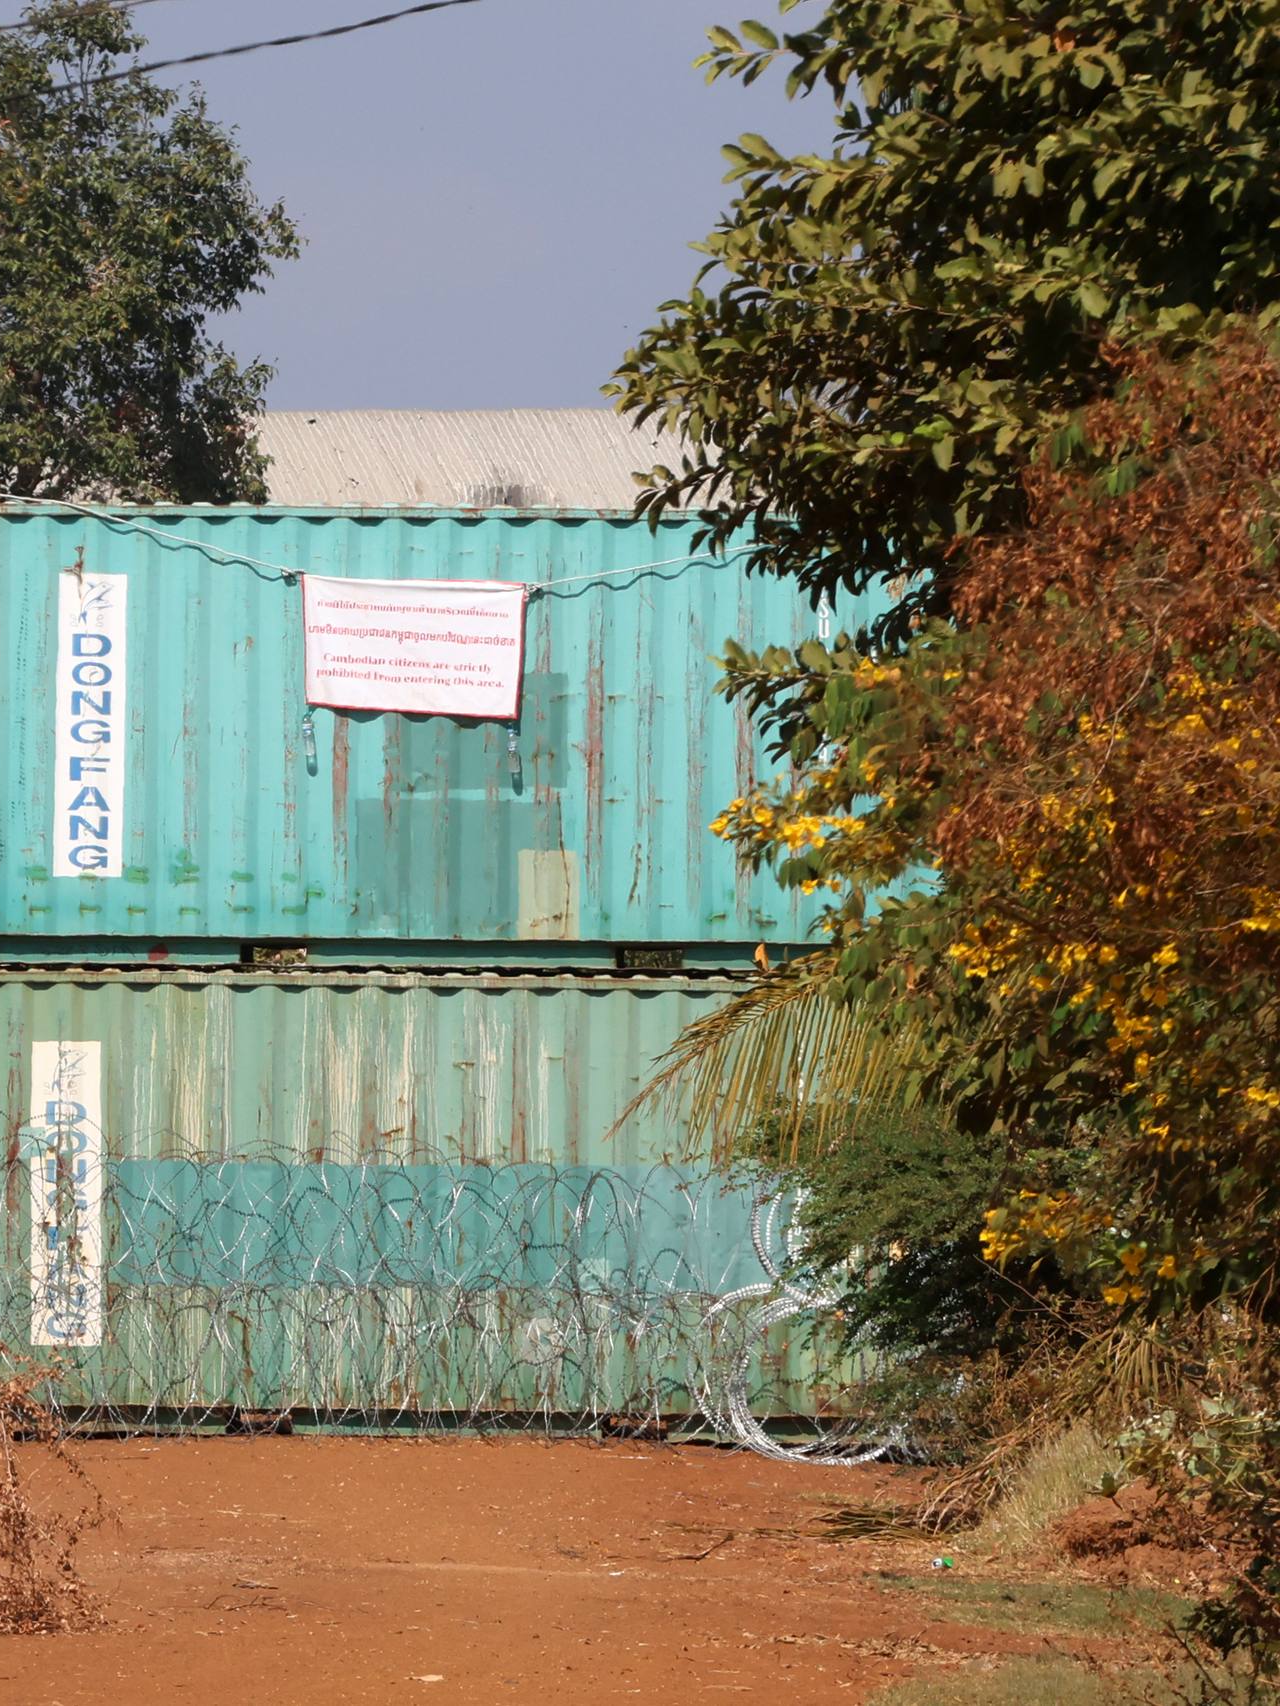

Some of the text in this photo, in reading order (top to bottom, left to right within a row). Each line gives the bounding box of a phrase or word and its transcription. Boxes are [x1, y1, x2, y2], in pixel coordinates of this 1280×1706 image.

[70, 633, 113, 744] DONG
[316, 667, 371, 680] prohibited
[404, 673, 451, 687] entering
[453, 676, 474, 686] this
[477, 679, 505, 689] area.
[323, 652, 492, 675] Cambodian citizens are strictly
[67, 756, 111, 869] FANG
